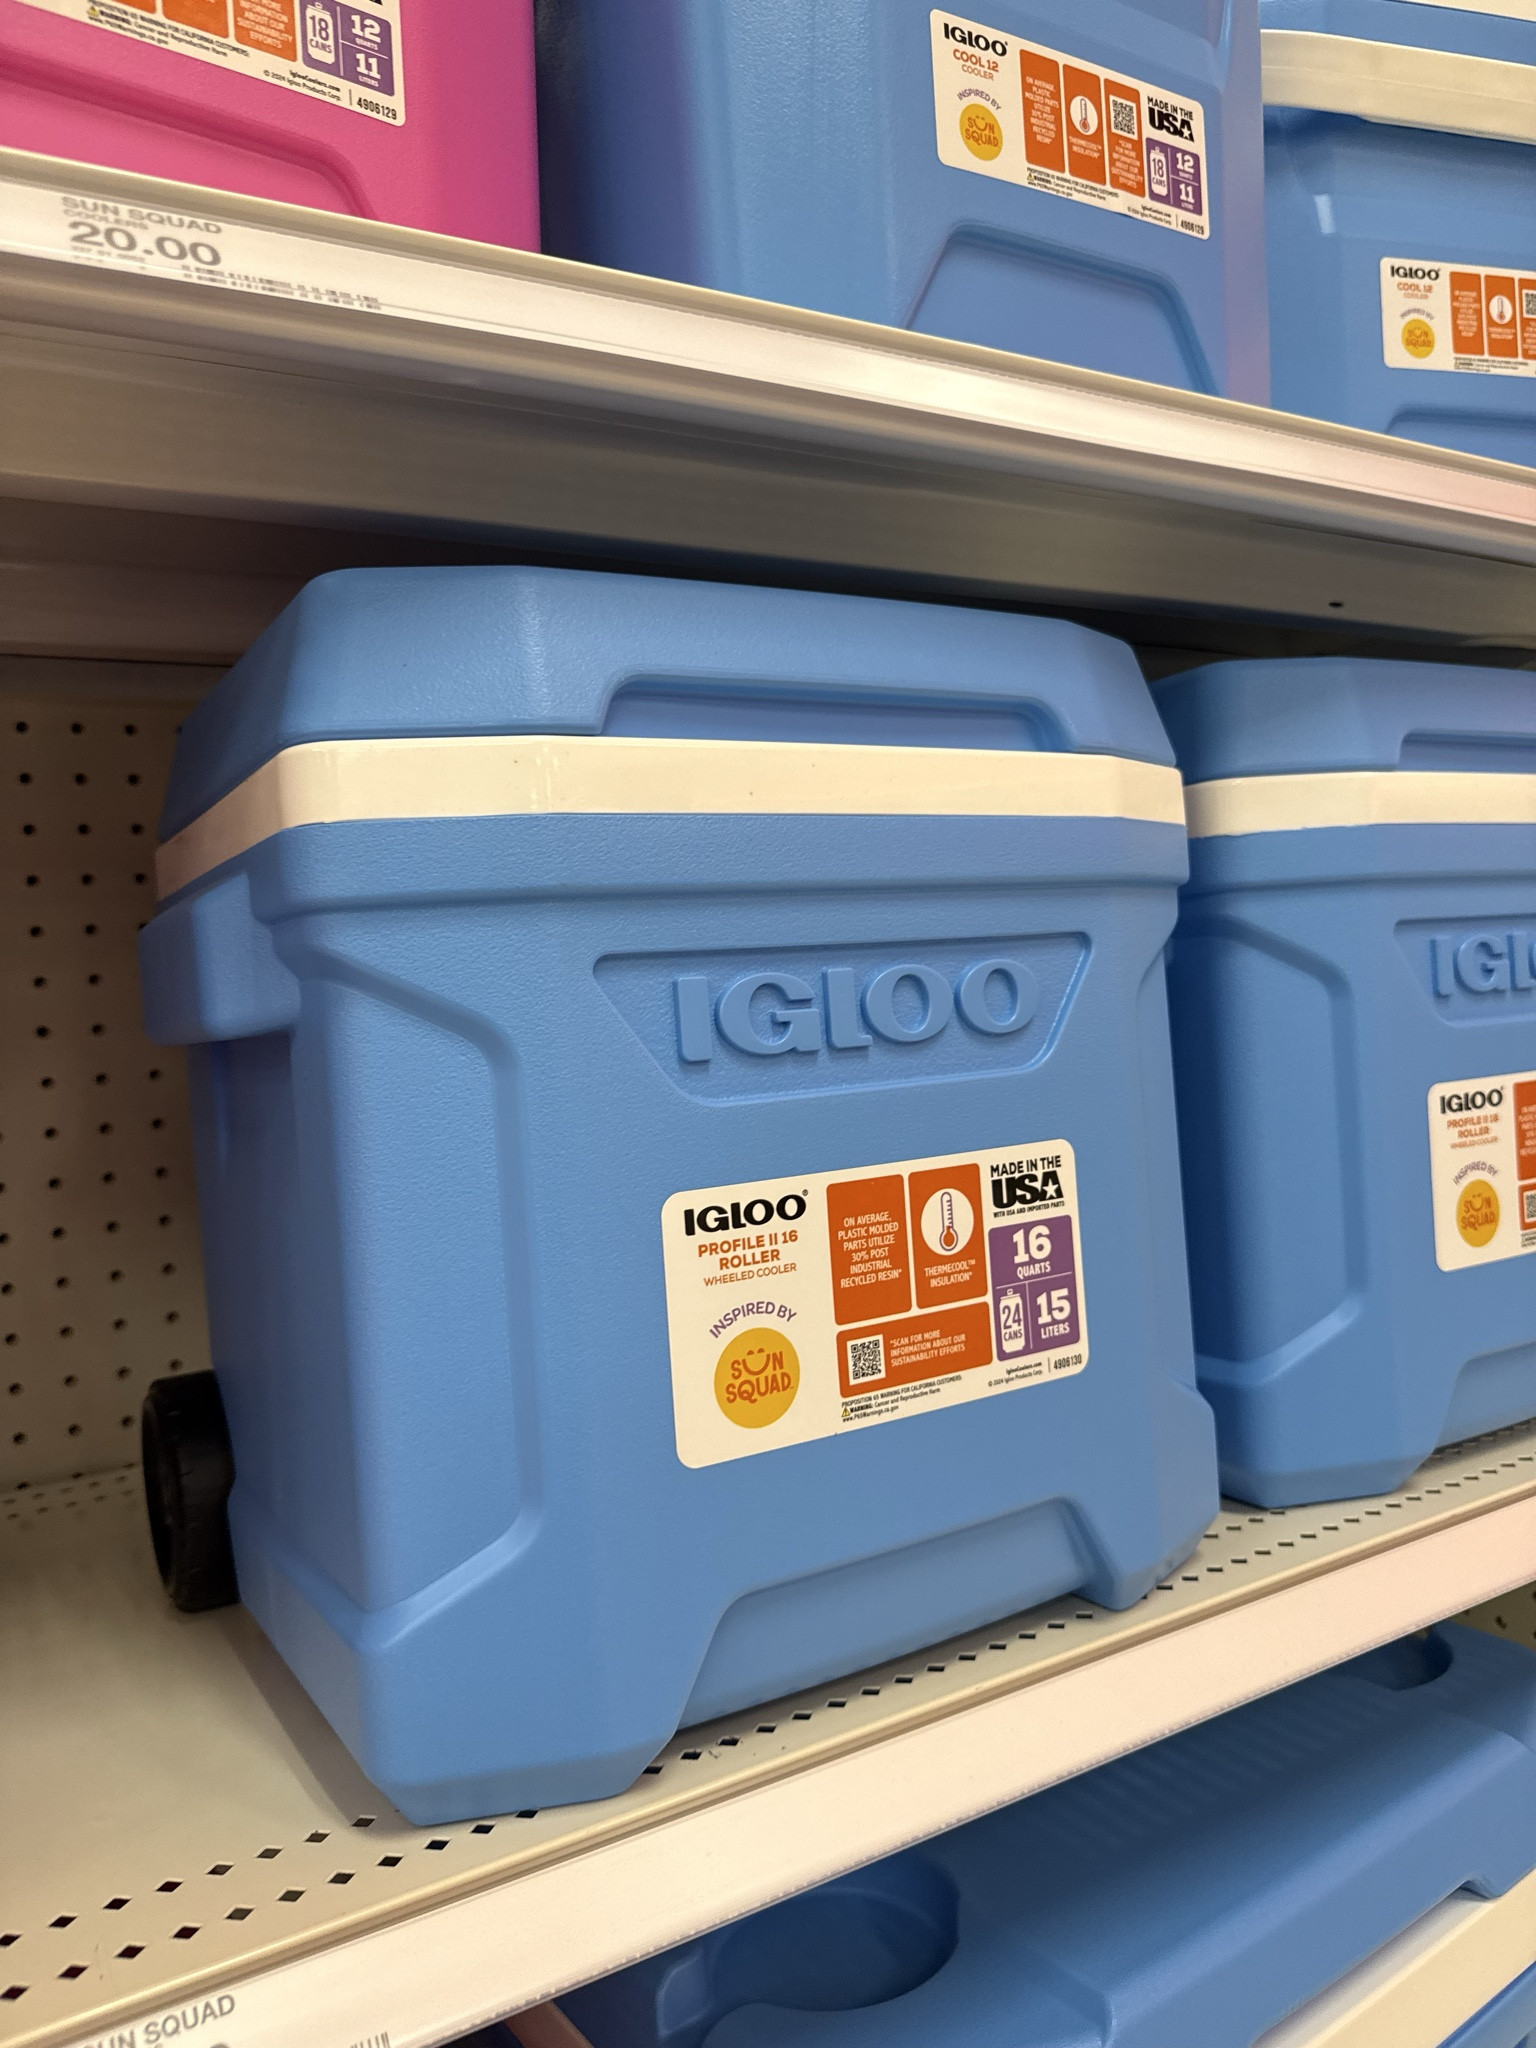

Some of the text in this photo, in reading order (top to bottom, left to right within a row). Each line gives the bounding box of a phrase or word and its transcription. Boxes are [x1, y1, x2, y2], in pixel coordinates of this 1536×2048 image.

[310, 16, 329, 42] 18
[351, 15, 381, 42] 12
[310, 39, 332, 54] CANS
[355, 37, 378, 50] QUARTS
[944, 23, 1007, 57] IGLOO
[356, 53, 381, 79] 11
[953, 49, 999, 72] COOL 12
[962, 64, 994, 80] COOLER
[357, 97, 397, 121] 4906129
[957, 88, 1001, 110] INSPIRED BY
[1148, 96, 1193, 121] MADE IN THE
[967, 116, 995, 135] SUN
[1148, 107, 1195, 143] USA
[965, 129, 999, 147] SQUAD
[1153, 158, 1164, 177] 18
[1176, 153, 1194, 174] 12
[1152, 177, 1166, 188] CANS
[1180, 184, 1195, 204] 11
[62, 196, 222, 234] SUN SQUAD
[68, 221, 221, 266] 20.00
[1390, 265, 1439, 280] IGLOO
[1397, 282, 1420, 292] COOL
[1429, 931, 1536, 999] IGL
[674, 958, 1039, 1064] IGLOO
[1440, 1089, 1503, 1114] IGLOO
[1447, 1115, 1481, 1129] PROFILE
[1458, 1126, 1490, 1139] ROLLER
[990, 1155, 1061, 1177] MADE IN THE
[1453, 1161, 1486, 1185] INSPIRED
[991, 1170, 1064, 1209] USA
[1027, 1203, 1049, 1212] IMPORTED
[1051, 1200, 1064, 1208] PARTS
[1464, 1193, 1491, 1213] SUN
[684, 1194, 806, 1236] IGLOO
[844, 1211, 891, 1227] ON AVERAGE,
[1461, 1212, 1496, 1231] SQUAD
[838, 1222, 898, 1240] PLASTIC MOLDED
[698, 1230, 798, 1257] PROFILE II 16
[844, 1234, 895, 1251] PARTS UTILIZE
[1013, 1225, 1051, 1264] 16
[720, 1249, 780, 1270] ROLLER
[852, 1247, 889, 1262] 30% POST
[704, 1263, 796, 1286] WHEELED COOLER
[850, 1259, 892, 1274] INDUSTRIAL
[1017, 1261, 1051, 1279] QUARTS
[841, 1273, 876, 1288] RECYCLED
[1002, 1303, 1021, 1329] 24
[1037, 1288, 1070, 1325] 15
[709, 1301, 797, 1338] INSPIRED BY
[1041, 1322, 1070, 1339] LITERS
[891, 1334, 966, 1356] INFORMATION ABOUT OUR
[910, 1334, 922, 1343] FOR
[924, 1329, 940, 1340] MORE
[1004, 1329, 1022, 1341] CANS
[731, 1348, 784, 1380] SUN
[891, 1343, 965, 1366] SUSTAINABILITY EFFORTS
[1054, 1354, 1082, 1370] 4906130
[726, 1371, 791, 1404] SQUAD
[842, 1396, 872, 1408] PROPOSITION
[880, 1389, 900, 1399] WARNING
[911, 1381, 936, 1392] CALIFORNIA
[875, 1399, 890, 1408] Cancer
[891, 1396, 899, 1404] and
[900, 1390, 928, 1403] Reproductive
[929, 1387, 940, 1395] Harm
[144, 1994, 236, 2044] SQUAD
